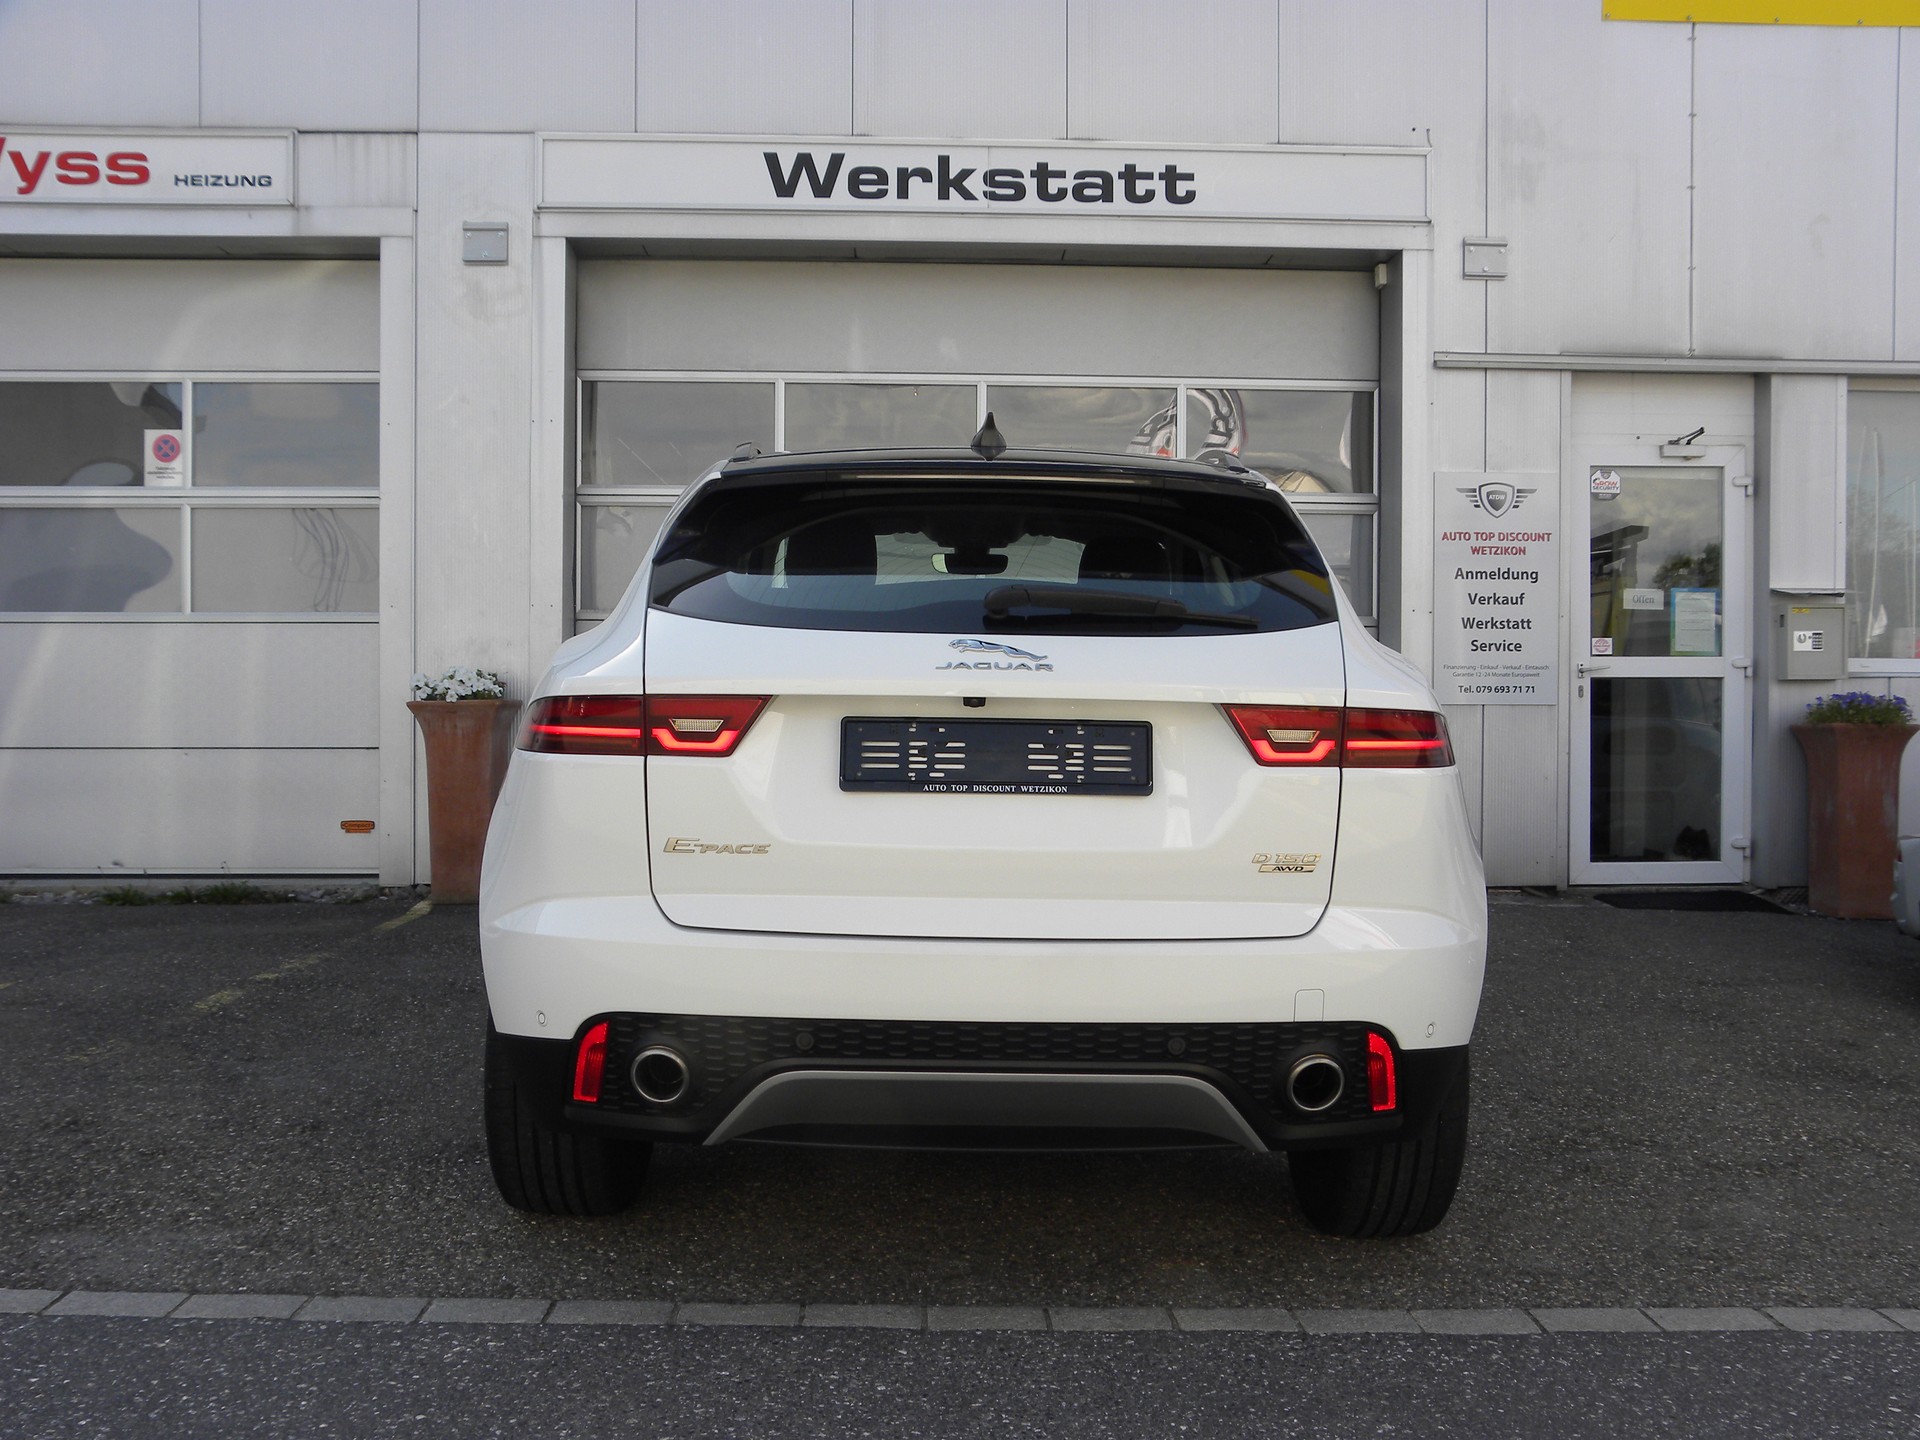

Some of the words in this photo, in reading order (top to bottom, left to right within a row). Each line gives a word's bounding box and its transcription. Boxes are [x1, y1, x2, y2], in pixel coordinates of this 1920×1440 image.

[0, 136, 150, 195] yss
[174, 174, 272, 187] HEIZUNG
[763, 151, 1197, 205] Werkstatt
[1441, 532, 1471, 541] AUTO
[1474, 532, 1495, 541] TOP
[1498, 532, 1552, 542] DISCOUNT
[1470, 546, 1527, 555] WETZIKON
[1454, 567, 1539, 584] Anmeldung
[1468, 592, 1525, 605] Verkauf
[1632, 594, 1655, 604] Offen
[1461, 617, 1532, 630] Werkstatt
[1470, 639, 1522, 652] Service
[935, 661, 1054, 672] JAGUAR
[1458, 685, 1475, 693] Tel.
[1476, 685, 1492, 693] 079
[1494, 685, 1511, 693] 693
[1512, 685, 1522, 693] 71
[1525, 685, 1535, 693] 71
[922, 784, 946, 792] AUTO
[951, 784, 968, 792] TOP
[973, 784, 1016, 793] DISCOUNT
[1020, 785, 1068, 793] WETZIKON
